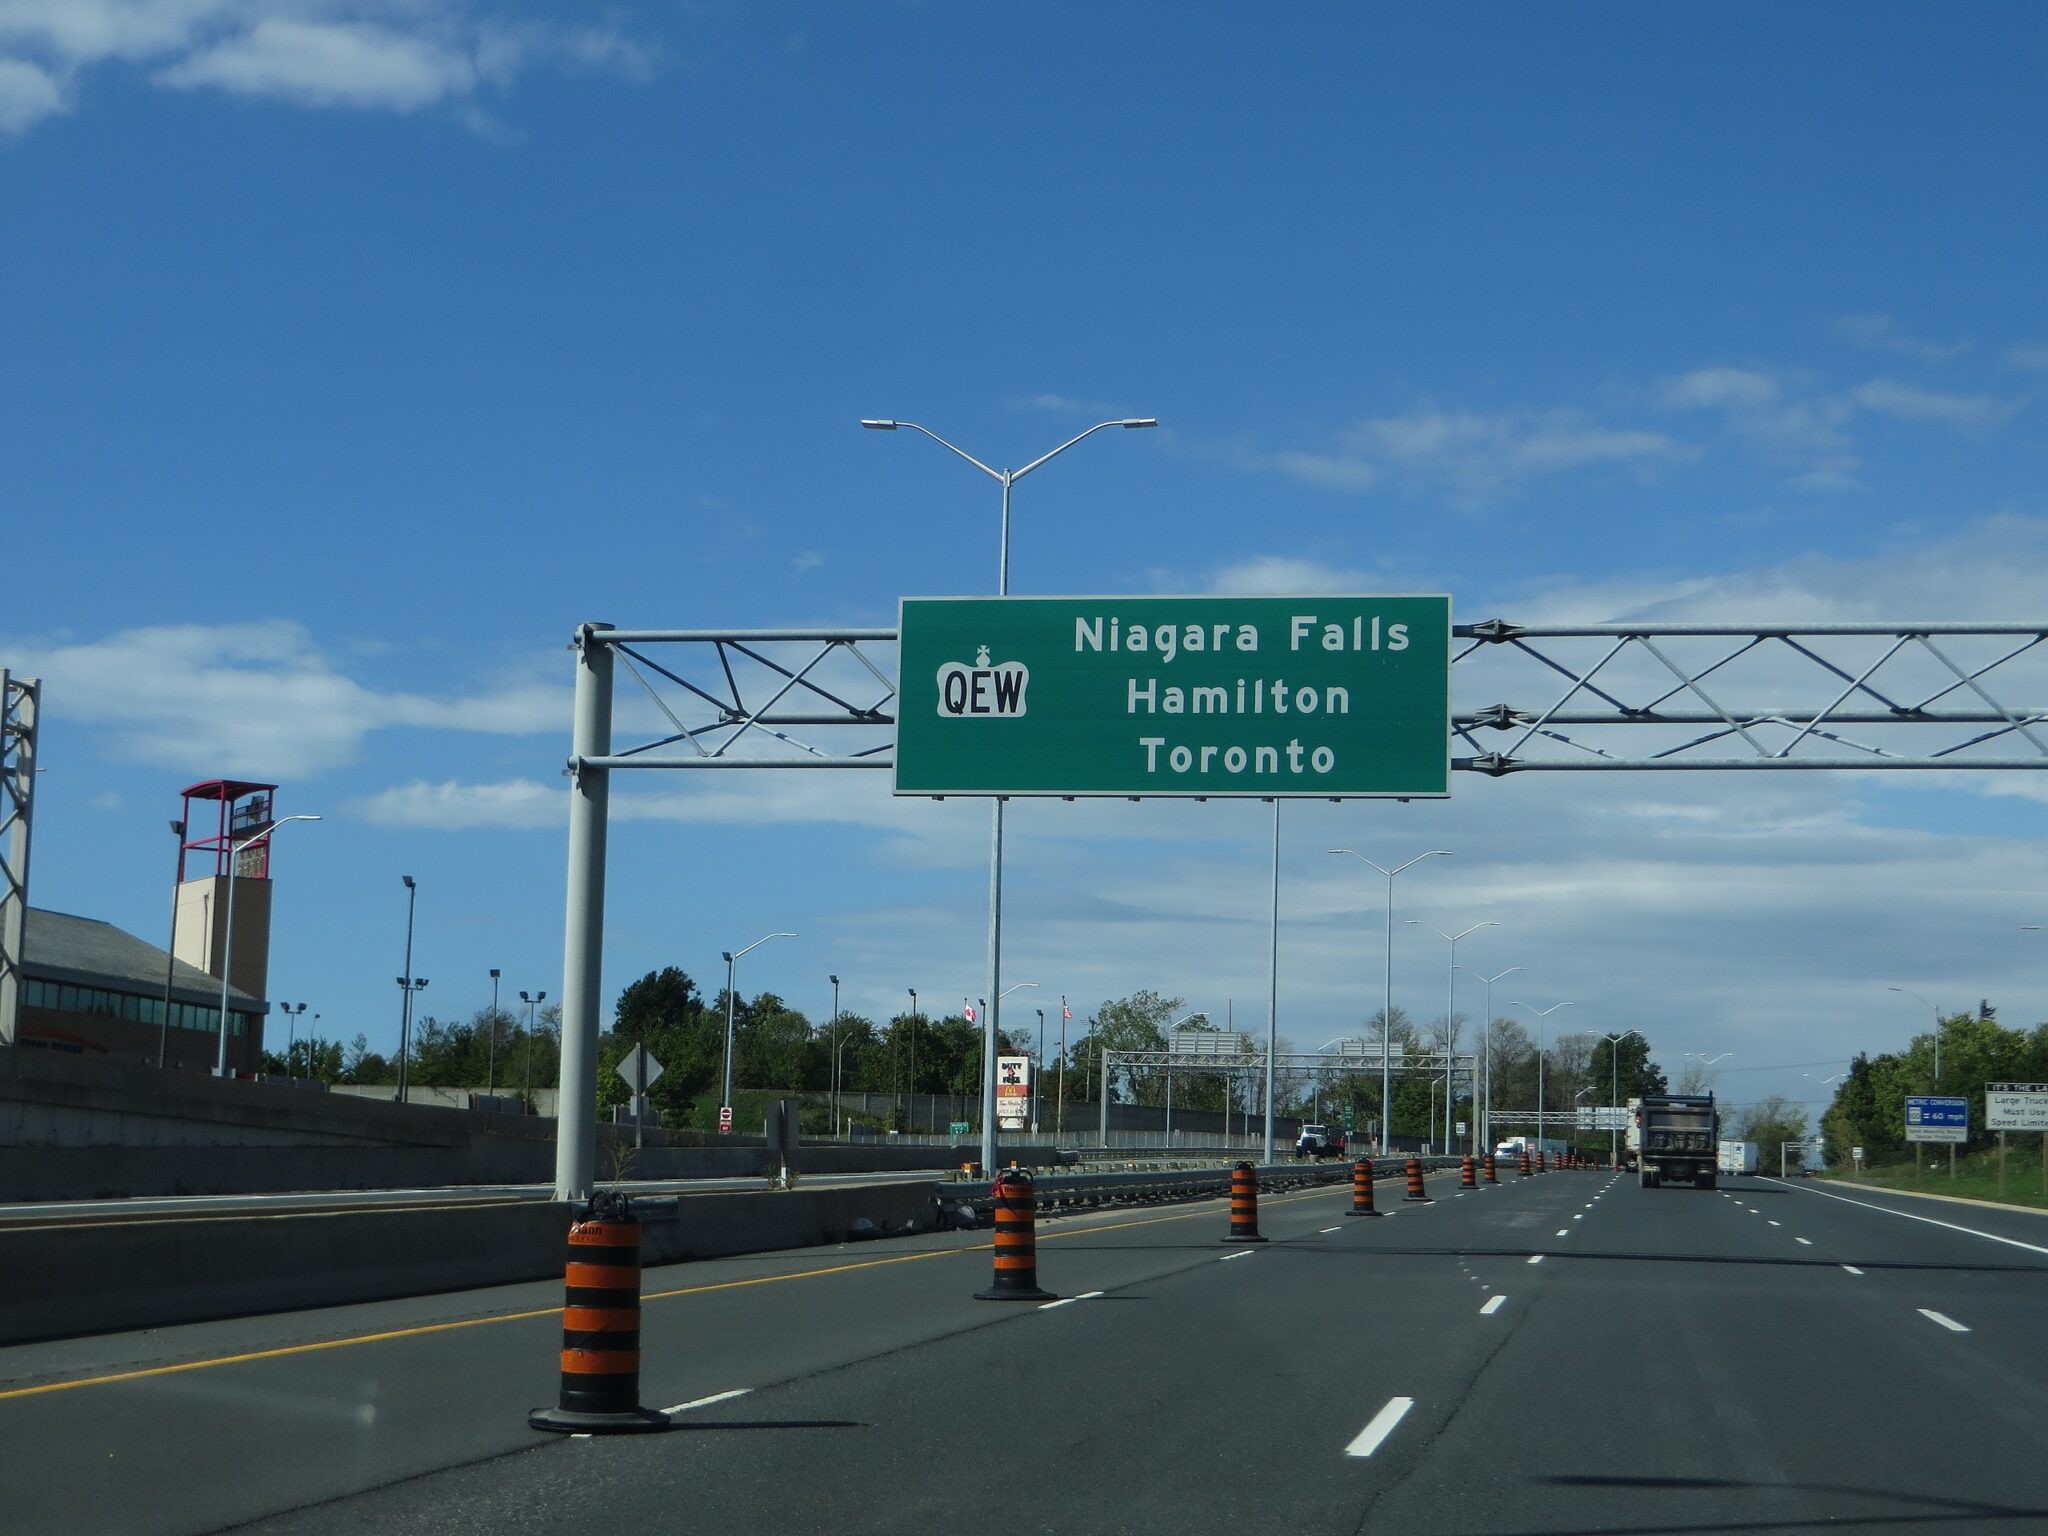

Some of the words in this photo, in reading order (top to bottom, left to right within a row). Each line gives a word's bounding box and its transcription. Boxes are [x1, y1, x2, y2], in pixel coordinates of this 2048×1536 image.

[1075, 616, 1258, 663] Niagara
[1291, 615, 1409, 651] Falls
[944, 670, 1023, 715] QEW
[1127, 678, 1349, 714] Hamilton
[1139, 737, 1335, 774] Toronto
[1994, 1097, 2020, 1105] Large
[1991, 1118, 2017, 1127] Speed
